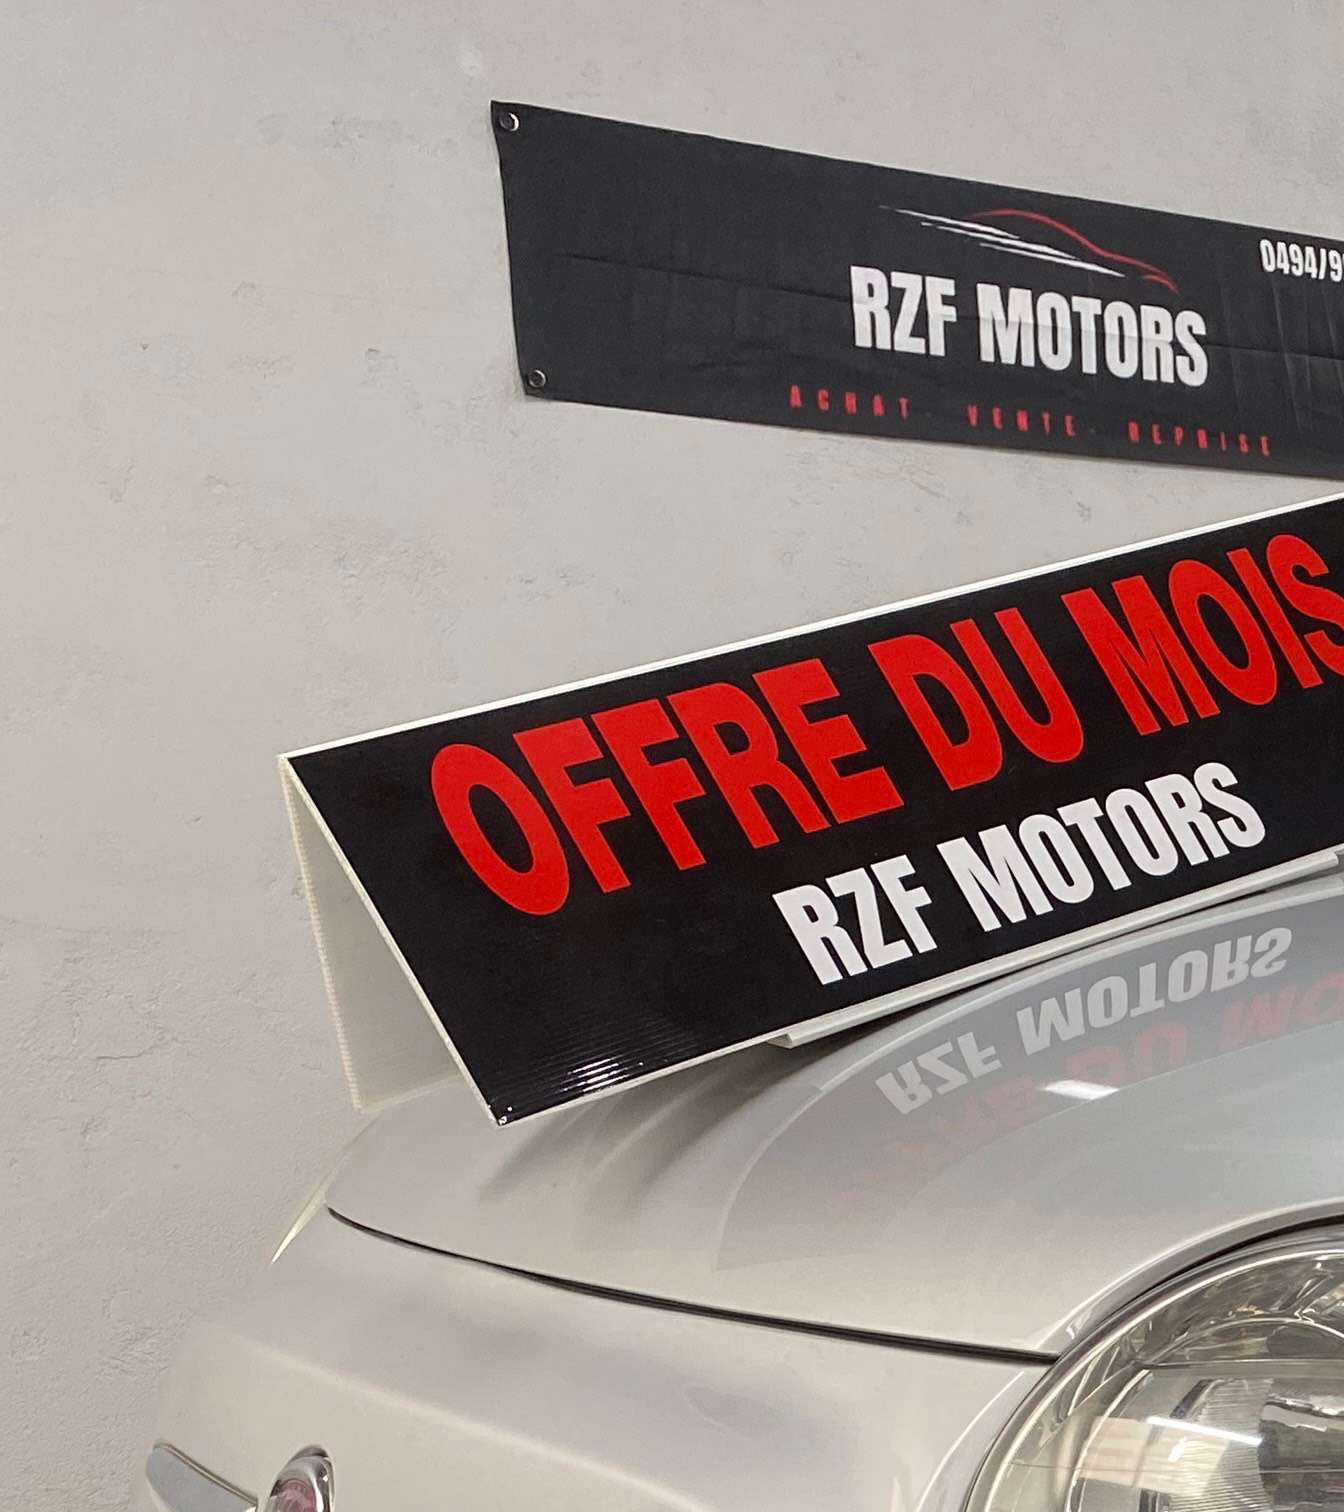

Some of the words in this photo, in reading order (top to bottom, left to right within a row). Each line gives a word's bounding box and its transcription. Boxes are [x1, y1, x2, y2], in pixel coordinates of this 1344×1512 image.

[850, 265, 957, 357] RZF
[976, 282, 1208, 387] MOTORS
[789, 385, 910, 420] ACHAT
[966, 405, 1076, 437] VENTE
[1127, 420, 1271, 457] REPRISE
[431, 658, 905, 917] OFFRE
[867, 607, 1085, 791] DU
[772, 854, 938, 986] RZF
[936, 762, 1266, 932] MOTORS
